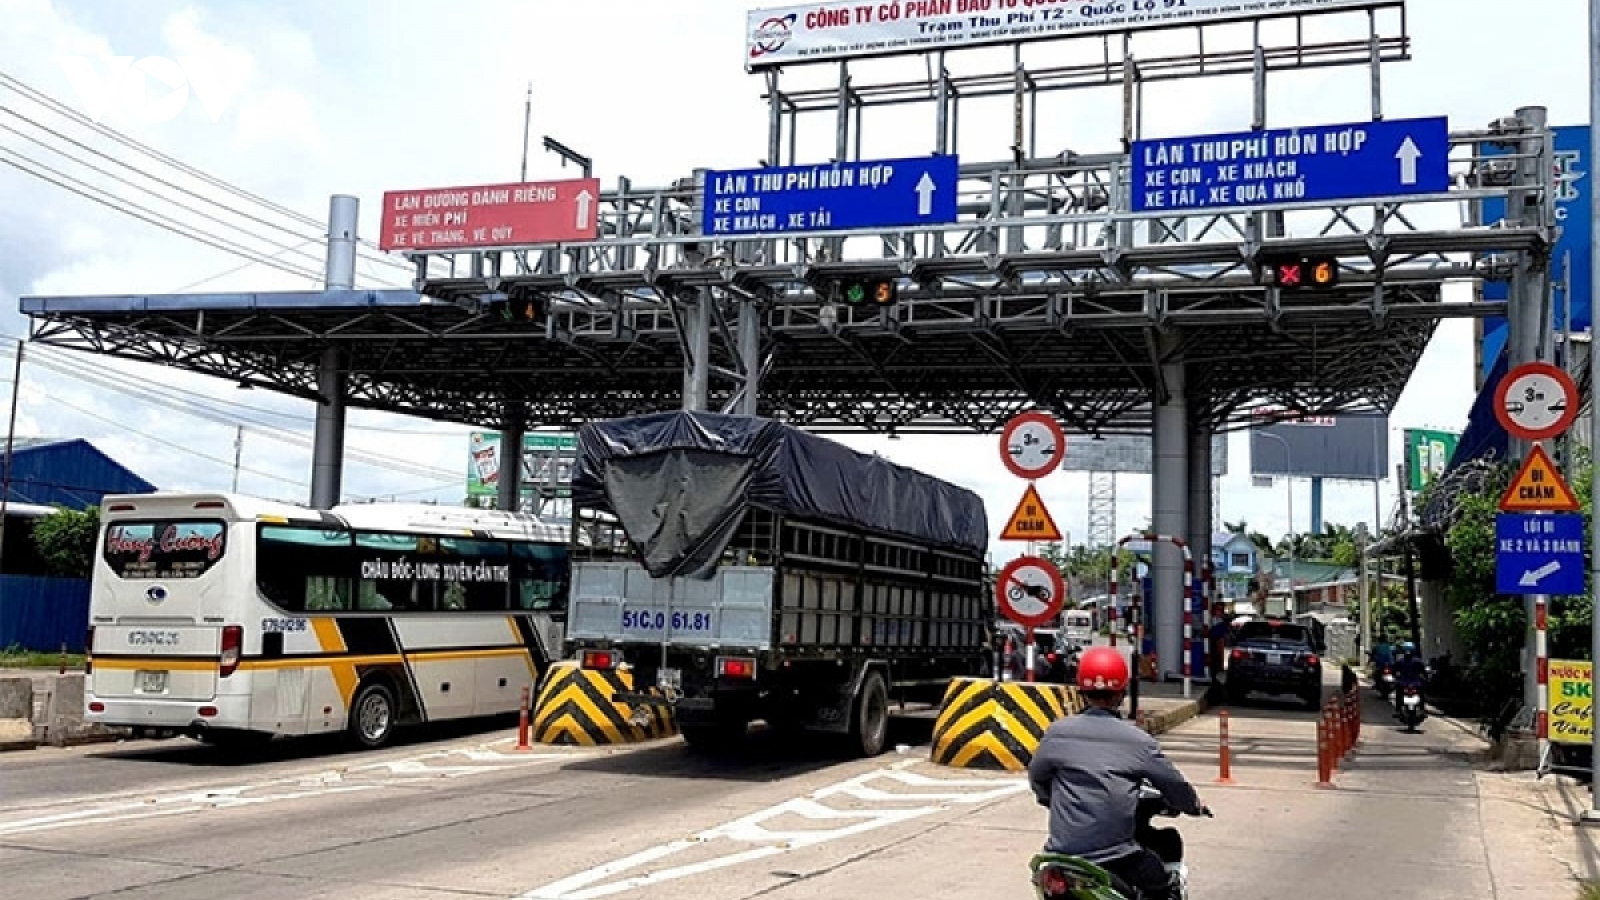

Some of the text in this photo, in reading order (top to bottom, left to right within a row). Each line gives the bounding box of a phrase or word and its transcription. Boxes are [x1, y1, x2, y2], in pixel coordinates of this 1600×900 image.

[806, 7, 849, 30] CÔNG
[855, 6, 873, 24] TY
[968, 16, 1000, 28] Thu
[1079, 1, 1126, 18] Quốc
[1144, 142, 1185, 166] LÀN
[1324, 129, 1367, 157] HỢP
[715, 174, 748, 195] LÀN
[859, 165, 893, 190] HỢP
[1144, 170, 1165, 187] XE
[1171, 167, 1201, 185] CON
[1217, 165, 1238, 181] XE
[715, 197, 760, 213] XE CON
[1144, 189, 1164, 207] XE
[1209, 185, 1230, 203] XE
[394, 215, 409, 227] XE
[443, 208, 469, 226] PHÍ
[713, 216, 732, 231] XE
[788, 213, 805, 227] XE
[1315, 262, 1329, 282] 6
[1515, 538, 1523, 553] 2
